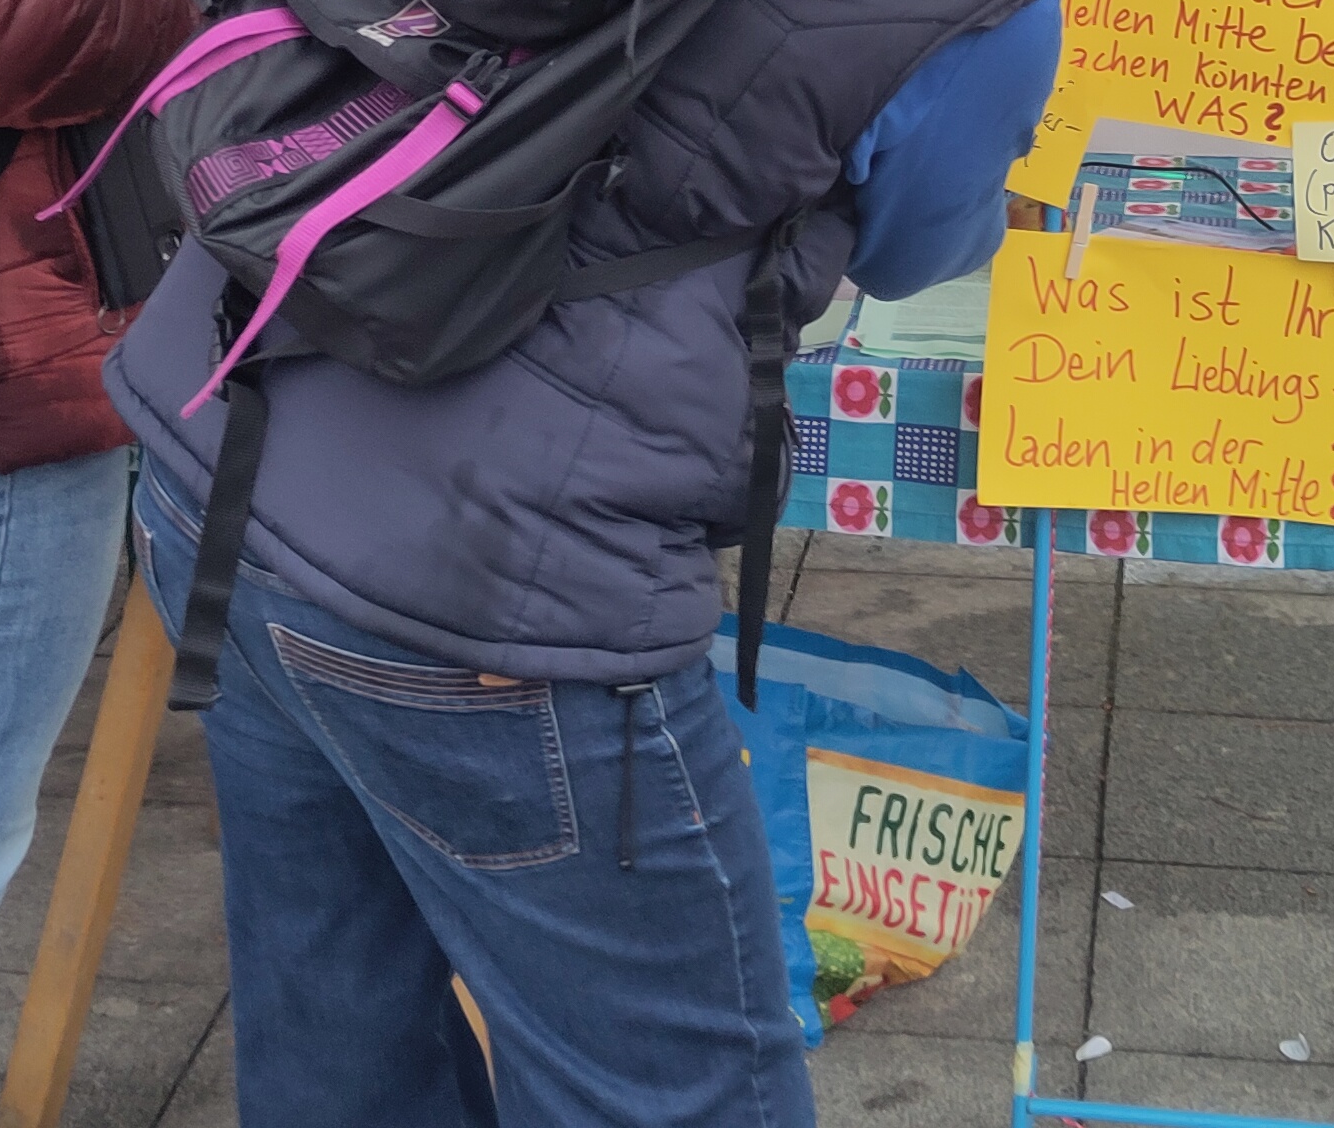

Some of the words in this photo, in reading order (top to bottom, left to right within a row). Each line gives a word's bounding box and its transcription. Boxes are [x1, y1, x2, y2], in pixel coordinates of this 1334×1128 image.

[1174, 0, 1277, 53] Mitte
[1068, 40, 1170, 83] achen
[1028, 256, 1131, 315] Was
[1173, 265, 1241, 326] ist
[1007, 332, 1137, 383] Dein
[1003, 403, 1111, 470] Laden
[1135, 426, 1174, 464] in
[1190, 417, 1265, 465] der
[1111, 468, 1210, 508] Hellen
[848, 784, 1013, 880] FRISCHE
